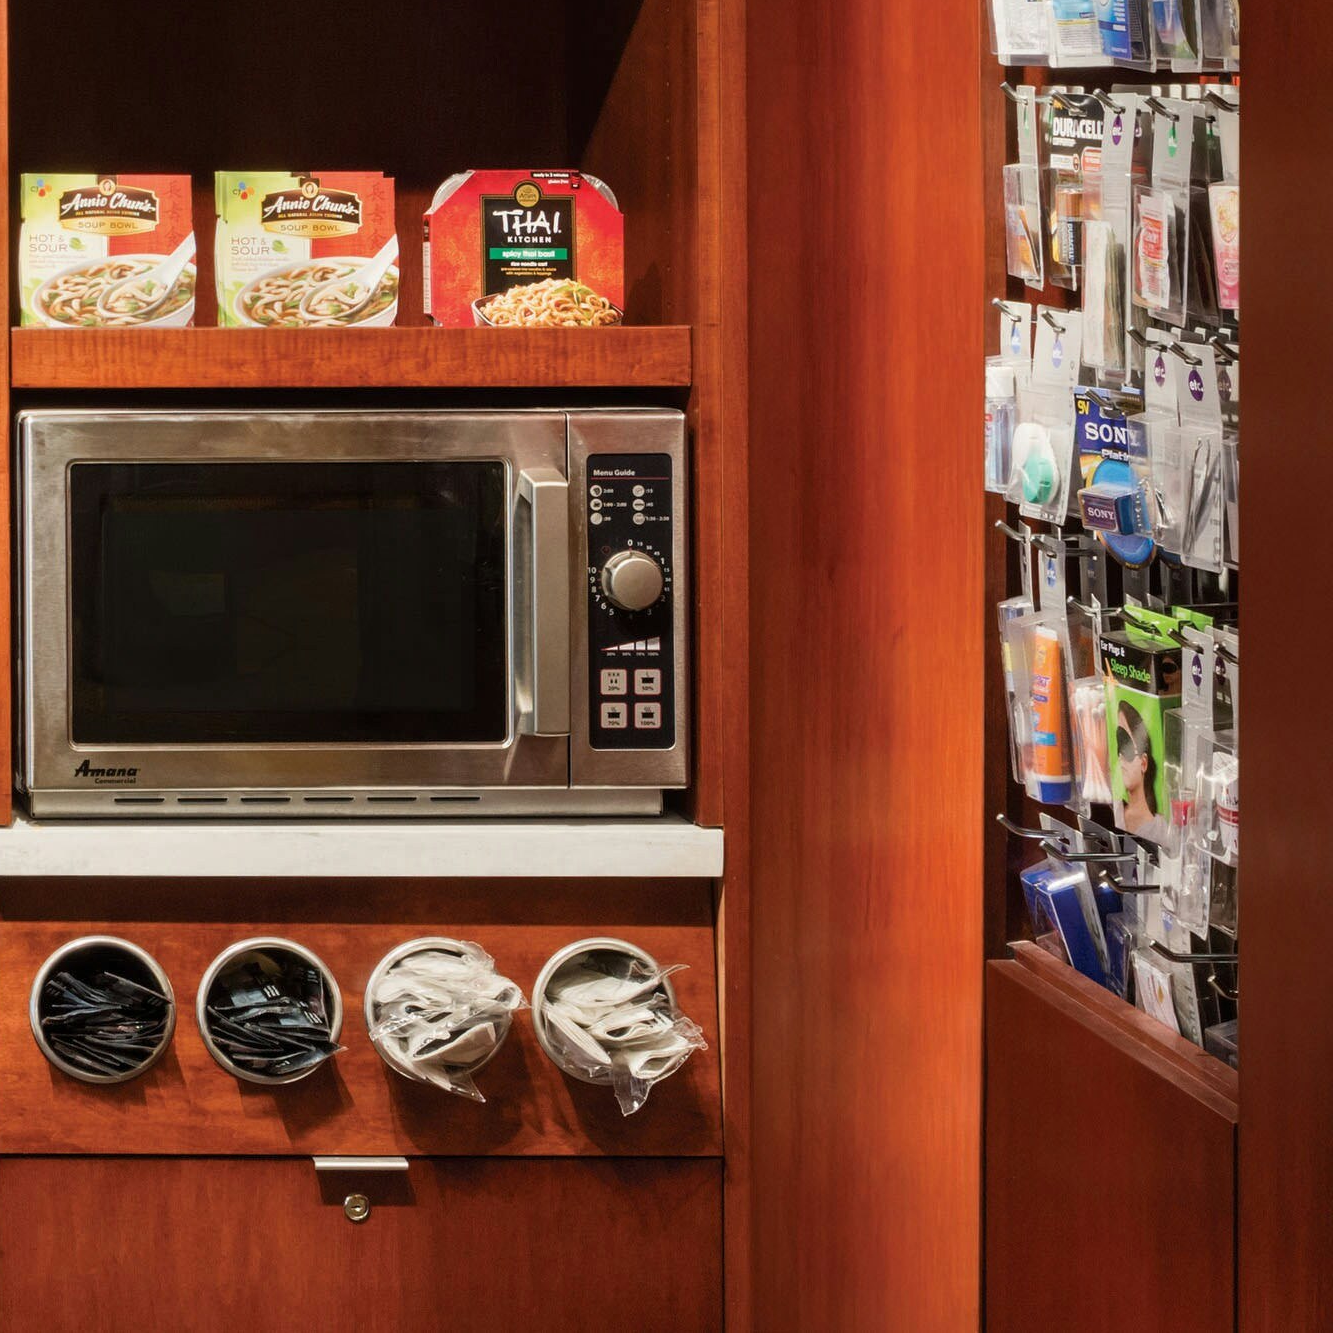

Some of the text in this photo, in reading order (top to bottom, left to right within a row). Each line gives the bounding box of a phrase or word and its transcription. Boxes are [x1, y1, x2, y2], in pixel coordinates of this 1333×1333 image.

[1053, 117, 1104, 139] DURACELL
[61, 193, 156, 215] Annie Chun's
[264, 195, 359, 218] Annie Chun's
[493, 210, 561, 235] THAI
[29, 244, 67, 252] SOUR
[231, 247, 270, 255] SOUR
[502, 250, 555, 259] spicy thai basil
[1078, 400, 1089, 415] 9V
[1085, 422, 1140, 446] SONY
[1088, 507, 1115, 520] SONY
[1107, 644, 1119, 657] Plugs
[1111, 660, 1150, 683] Sleep Shade
[75, 760, 137, 777] Amana
